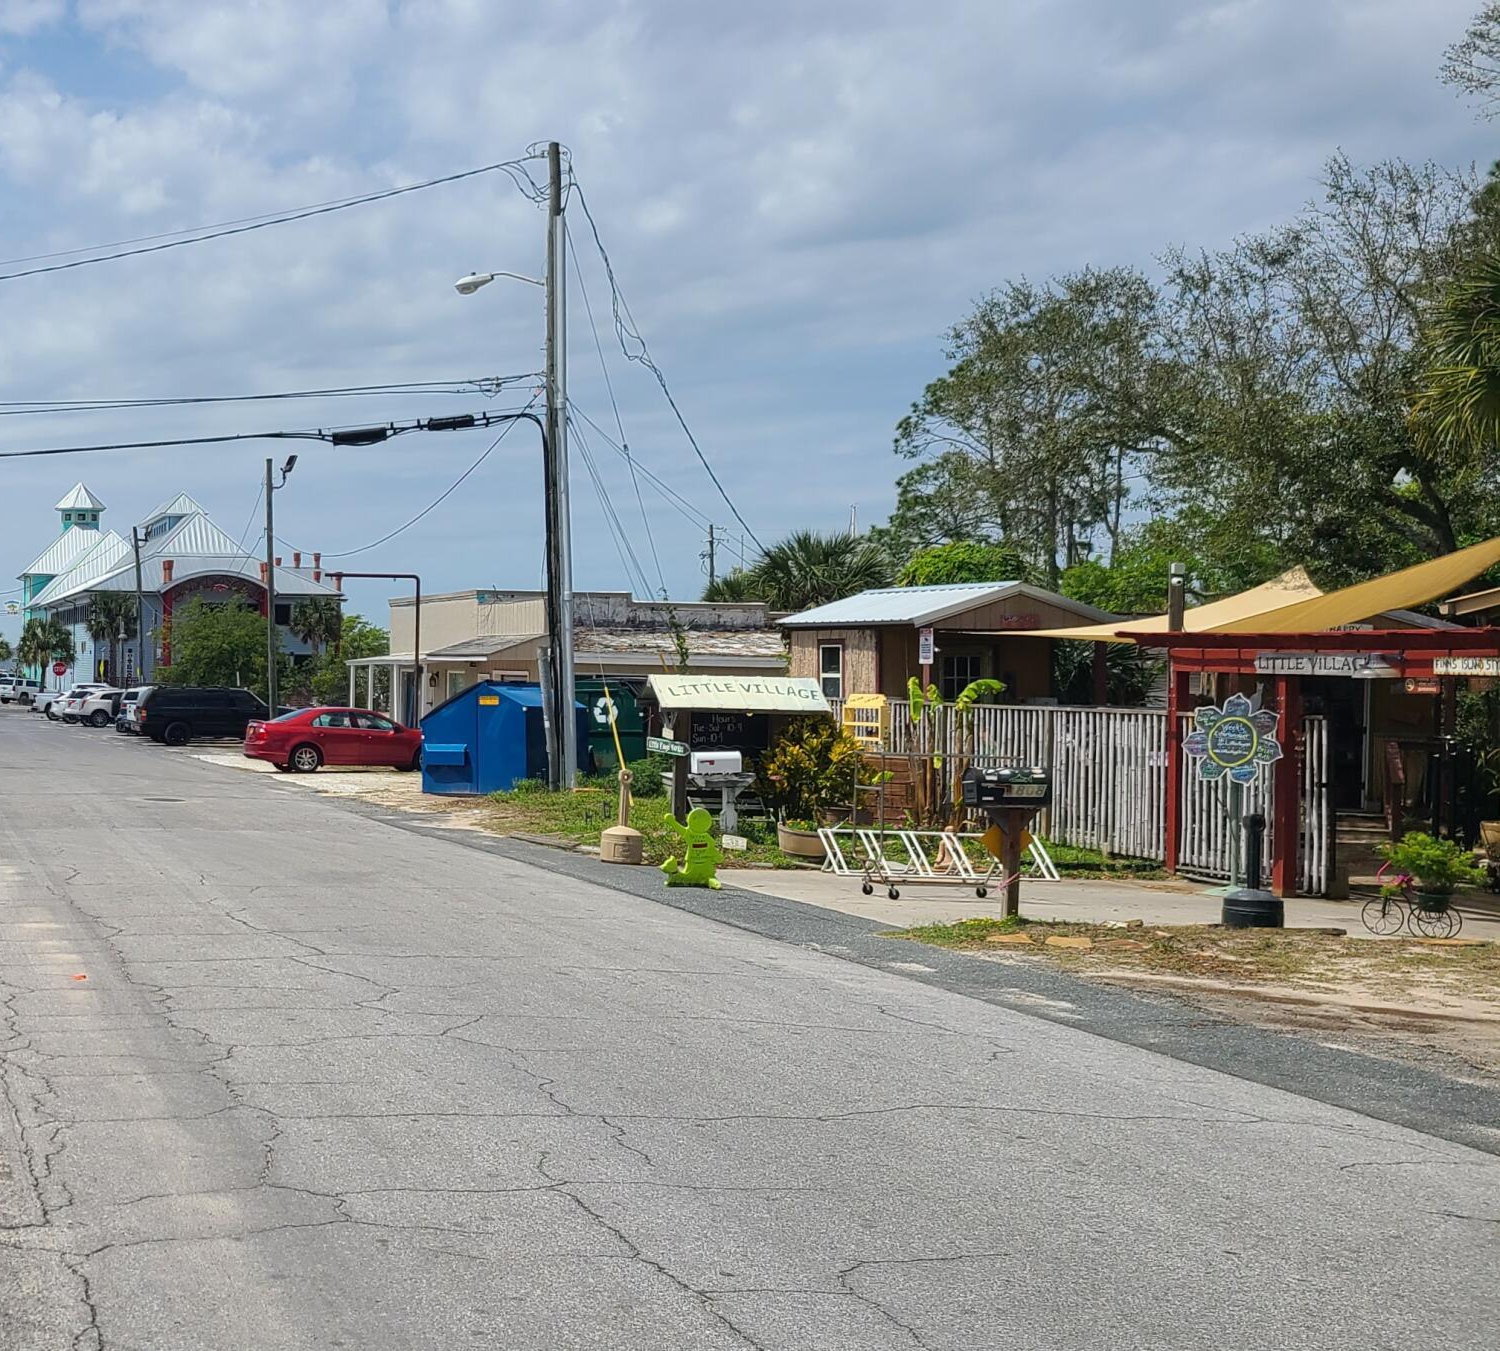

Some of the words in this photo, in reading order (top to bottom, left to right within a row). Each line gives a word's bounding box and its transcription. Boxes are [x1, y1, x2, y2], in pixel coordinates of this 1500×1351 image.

[1258, 656, 1305, 670] LITTLE
[668, 683, 737, 697] LITTLE
[739, 683, 820, 701] VILLAGE
